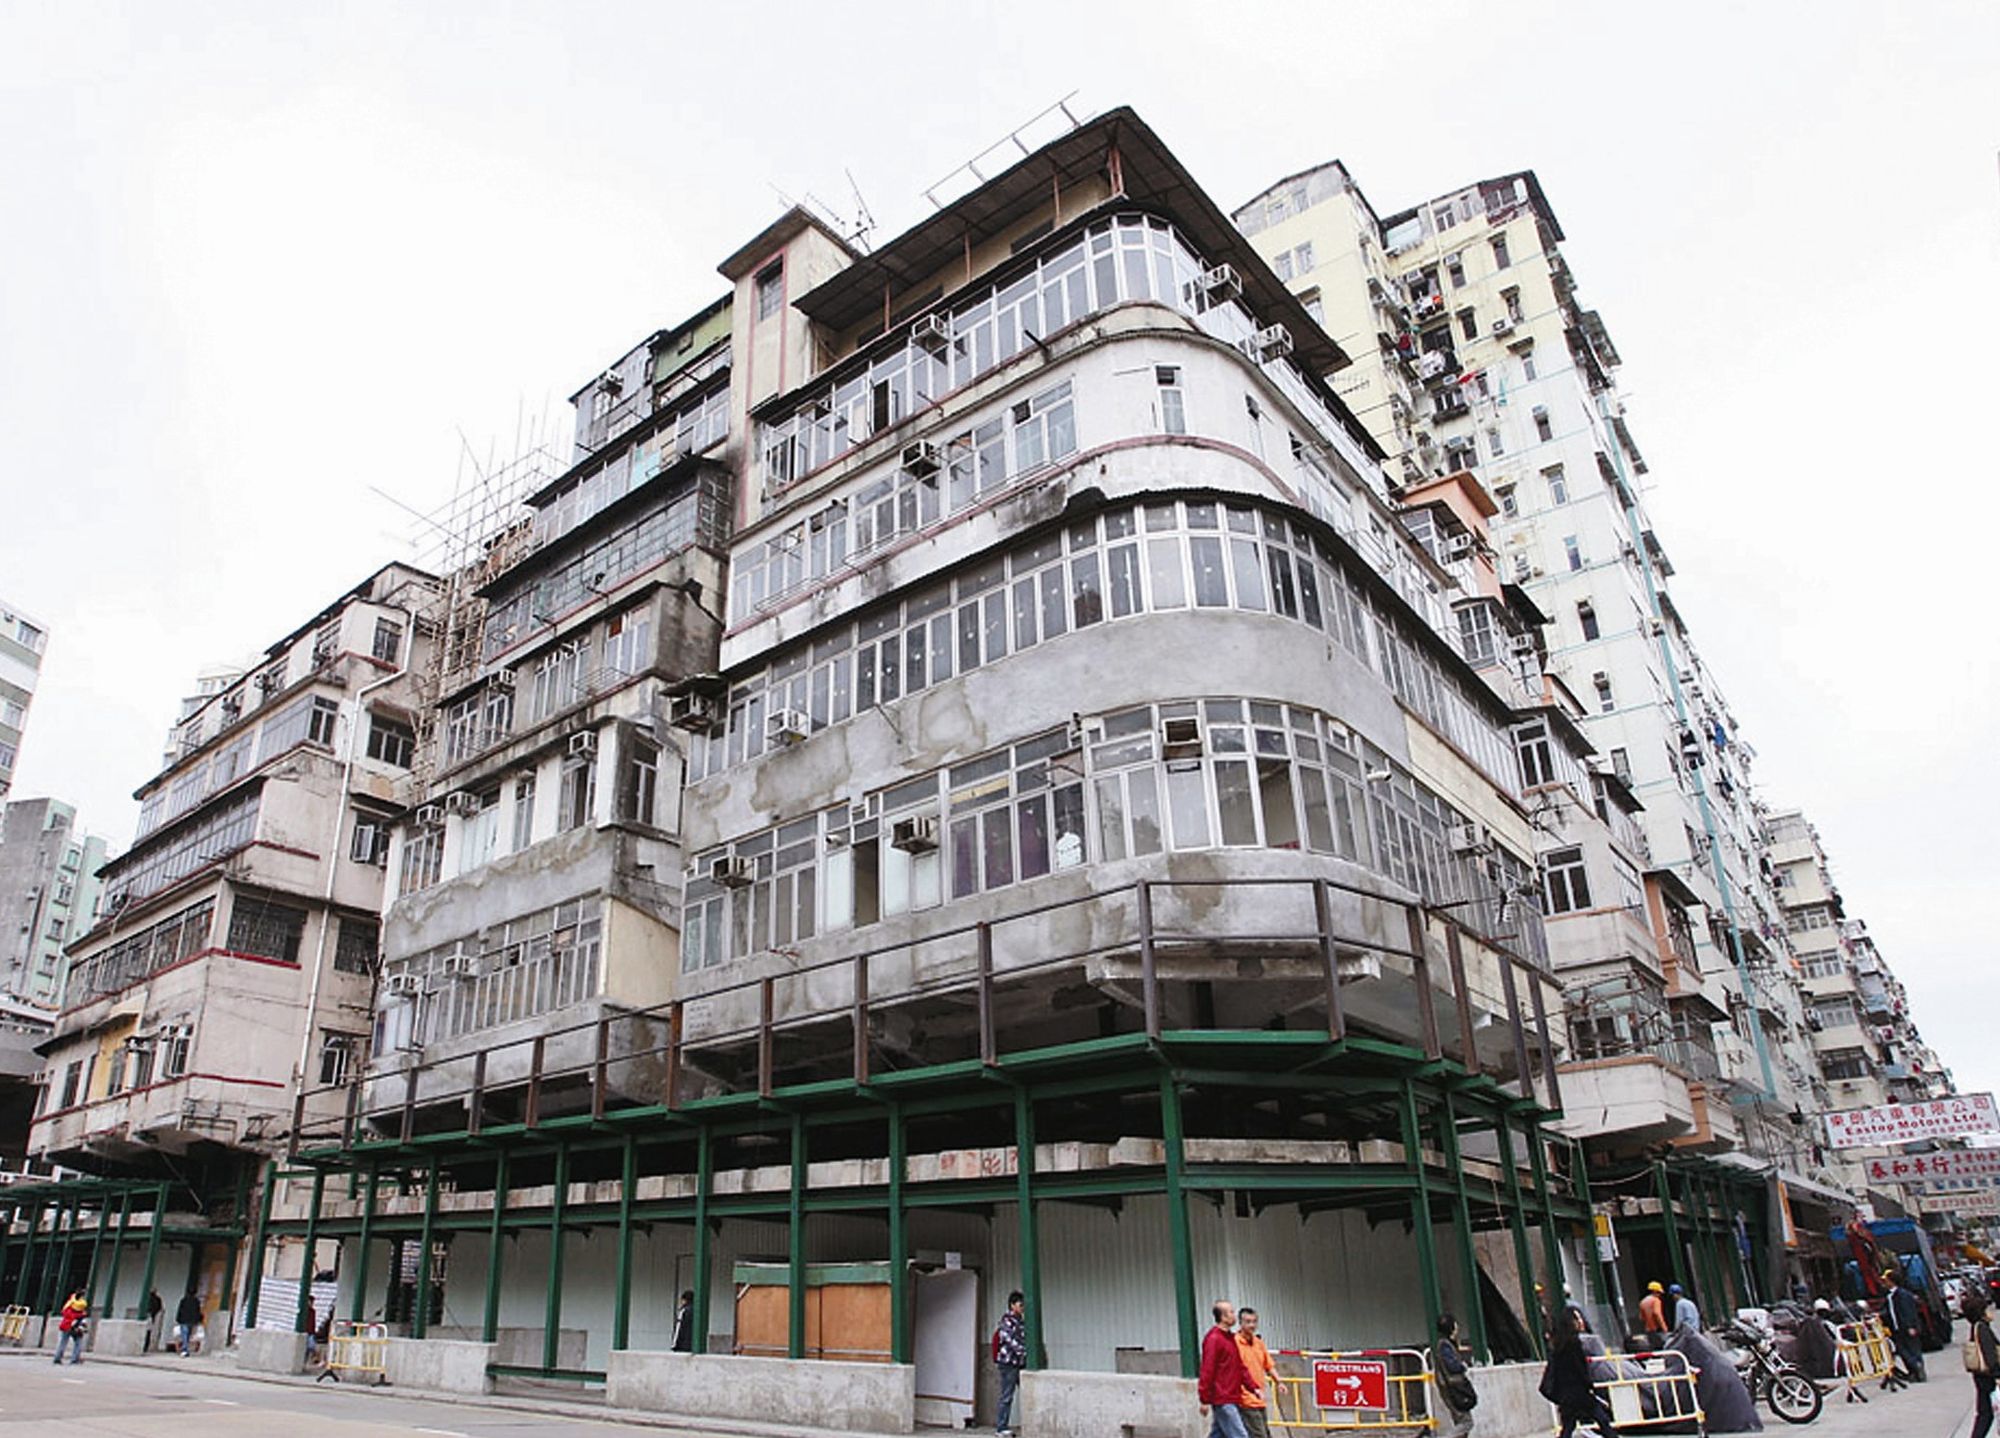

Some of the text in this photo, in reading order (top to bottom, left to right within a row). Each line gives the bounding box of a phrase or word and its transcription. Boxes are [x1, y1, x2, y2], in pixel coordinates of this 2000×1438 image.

[1845, 1123, 1894, 1136] Eastop
[1897, 1117, 1950, 1129] Motors
[1953, 1112, 1984, 1123] Ltd.
[1317, 1364, 1382, 1374] PEDESTRIANS
[1333, 1389, 1369, 1406] 行人
